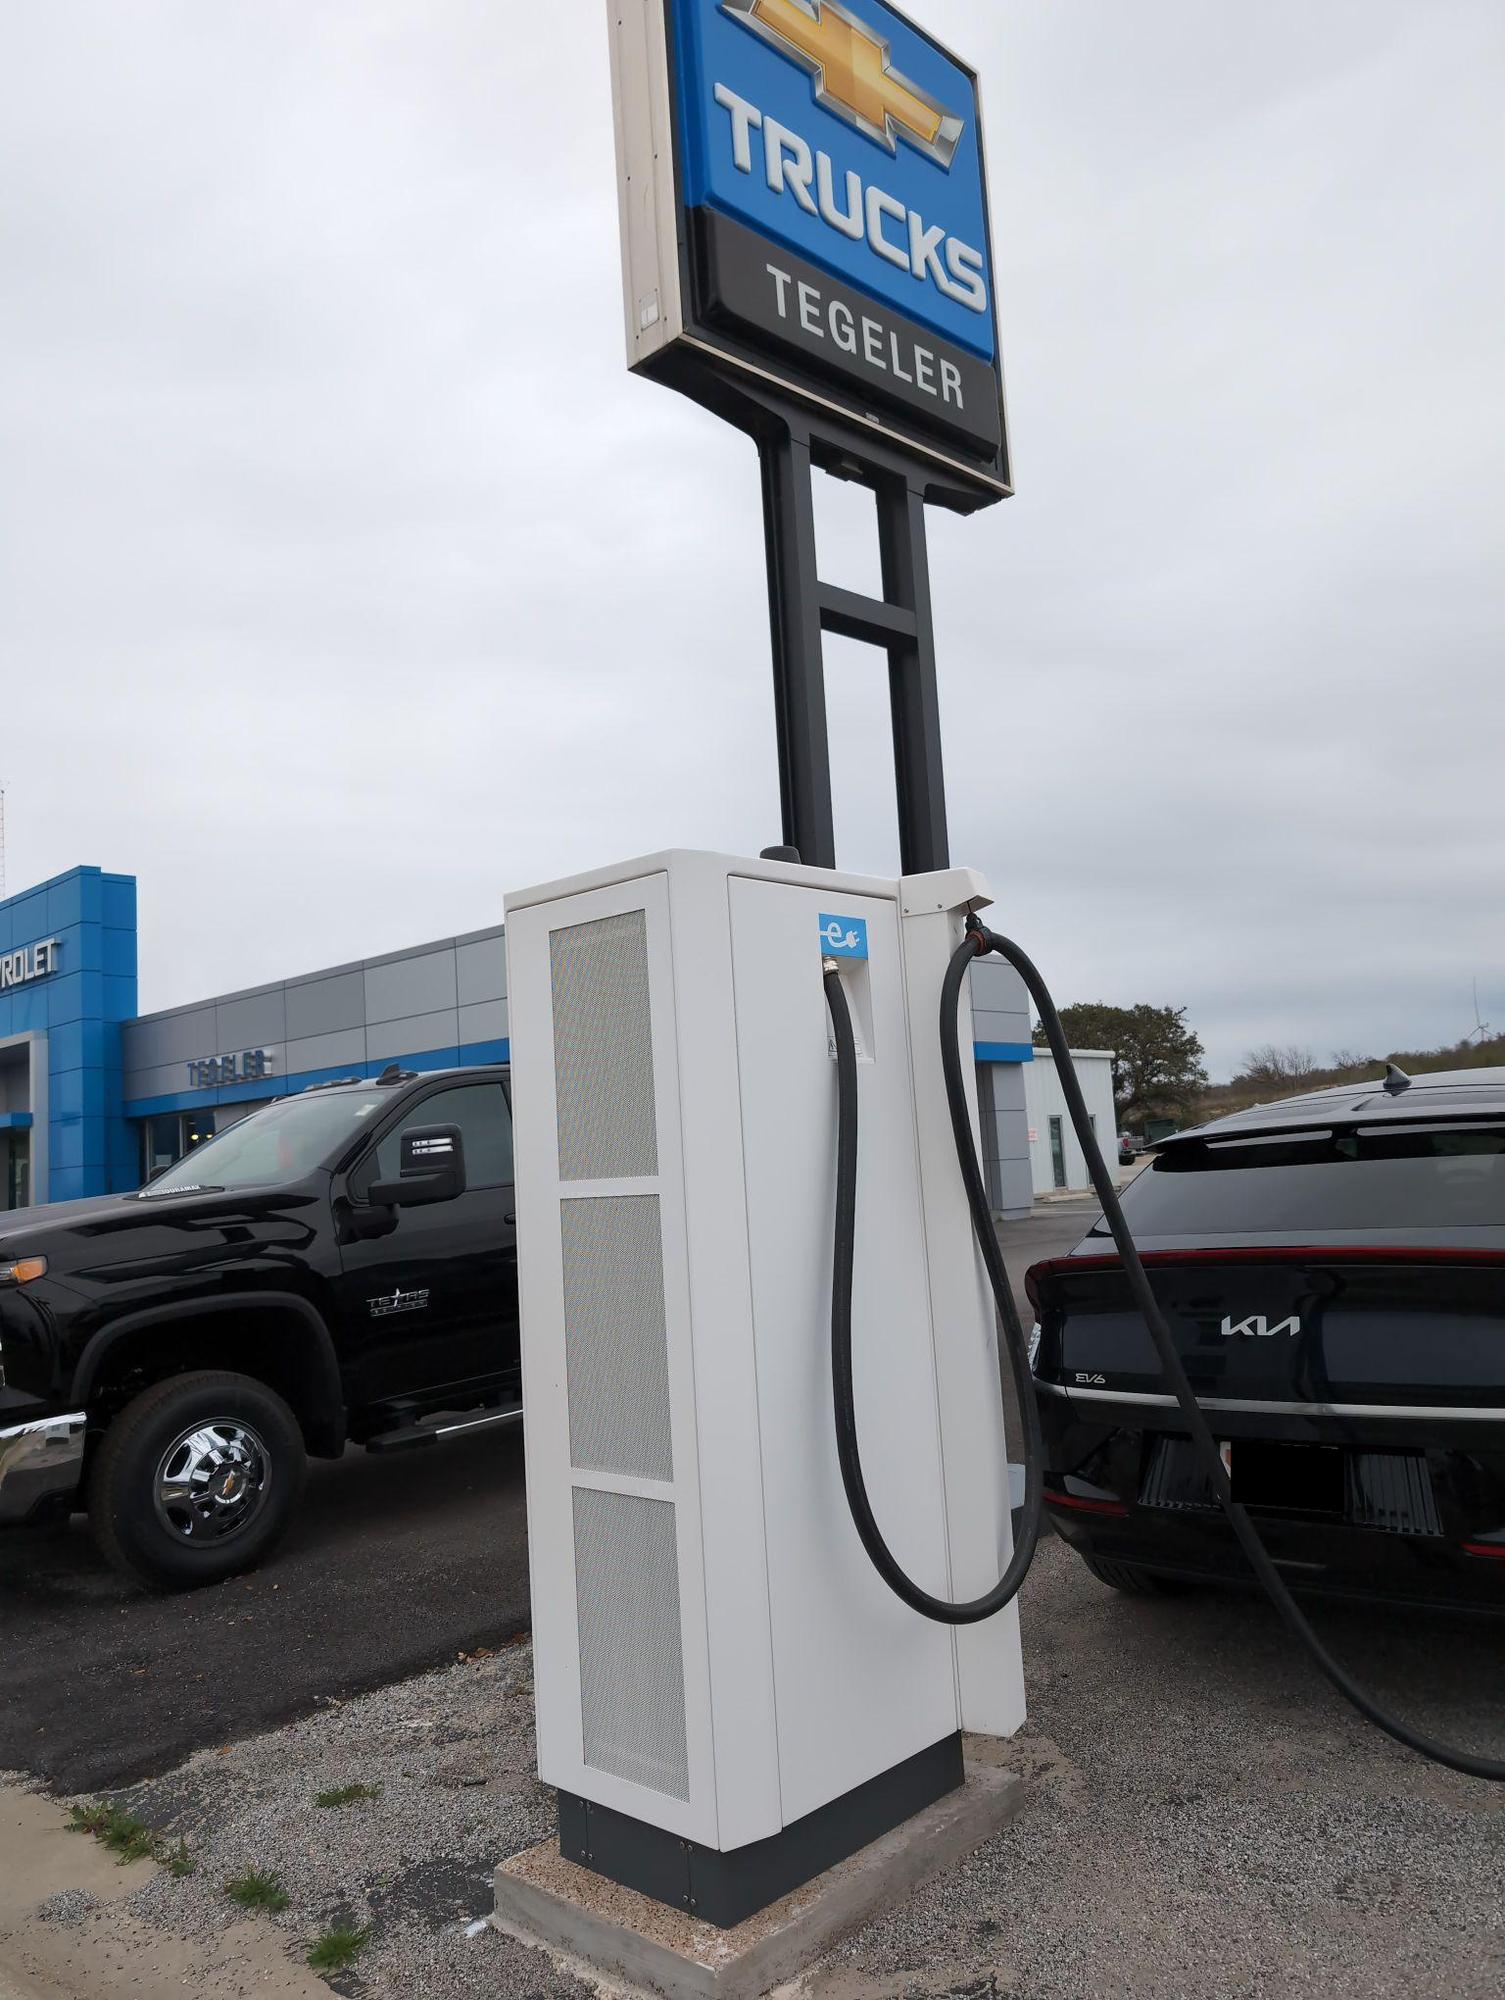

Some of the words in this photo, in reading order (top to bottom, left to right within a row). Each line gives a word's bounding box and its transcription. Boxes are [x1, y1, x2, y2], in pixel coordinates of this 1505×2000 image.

[714, 82, 987, 314] TRUCKS
[766, 263, 964, 410] TEGELER
[0, 937, 56, 988] ROLET
[1221, 1315, 1300, 1336] KIA
[1075, 1373, 1106, 1384] EV6
